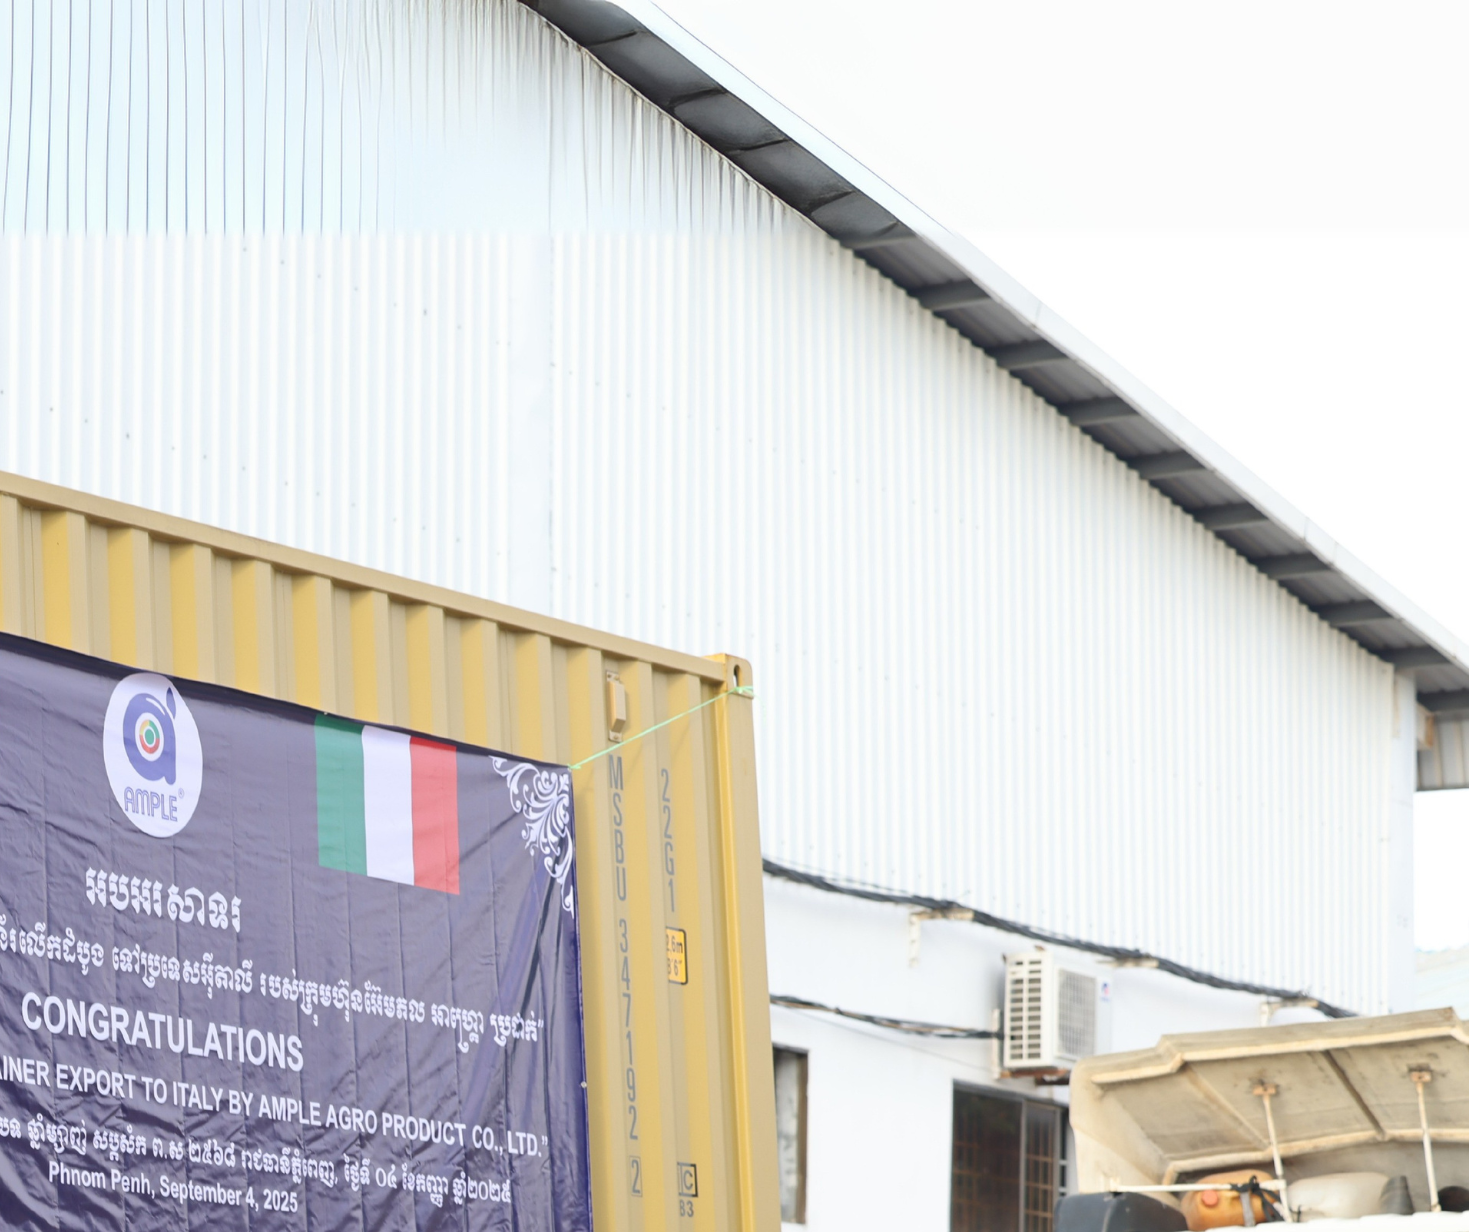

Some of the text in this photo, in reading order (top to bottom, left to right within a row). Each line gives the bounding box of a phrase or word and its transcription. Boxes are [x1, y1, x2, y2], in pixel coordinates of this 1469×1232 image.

[123, 786, 179, 823] AMPLE
[660, 768, 677, 913] 22G1
[85, 866, 242, 933] អបអរសាទរ
[608, 753, 641, 1194] MSBU 347192 2
[20, 991, 305, 1072] CONGRATULATIONS
[56, 1063, 137, 1099] EXPORT
[141, 1076, 168, 1103] TO
[172, 1082, 225, 1113] ITALY
[229, 1091, 254, 1117] BY
[257, 1095, 322, 1128] AMPLE
[325, 1104, 379, 1136] AGRO
[382, 1112, 468, 1148] PRODUCT
[471, 1124, 505, 1154] CO.,
[507, 1131, 549, 1159] LTD.”
[48, 1160, 299, 1214] Phnom Penh, September 4, 2025
